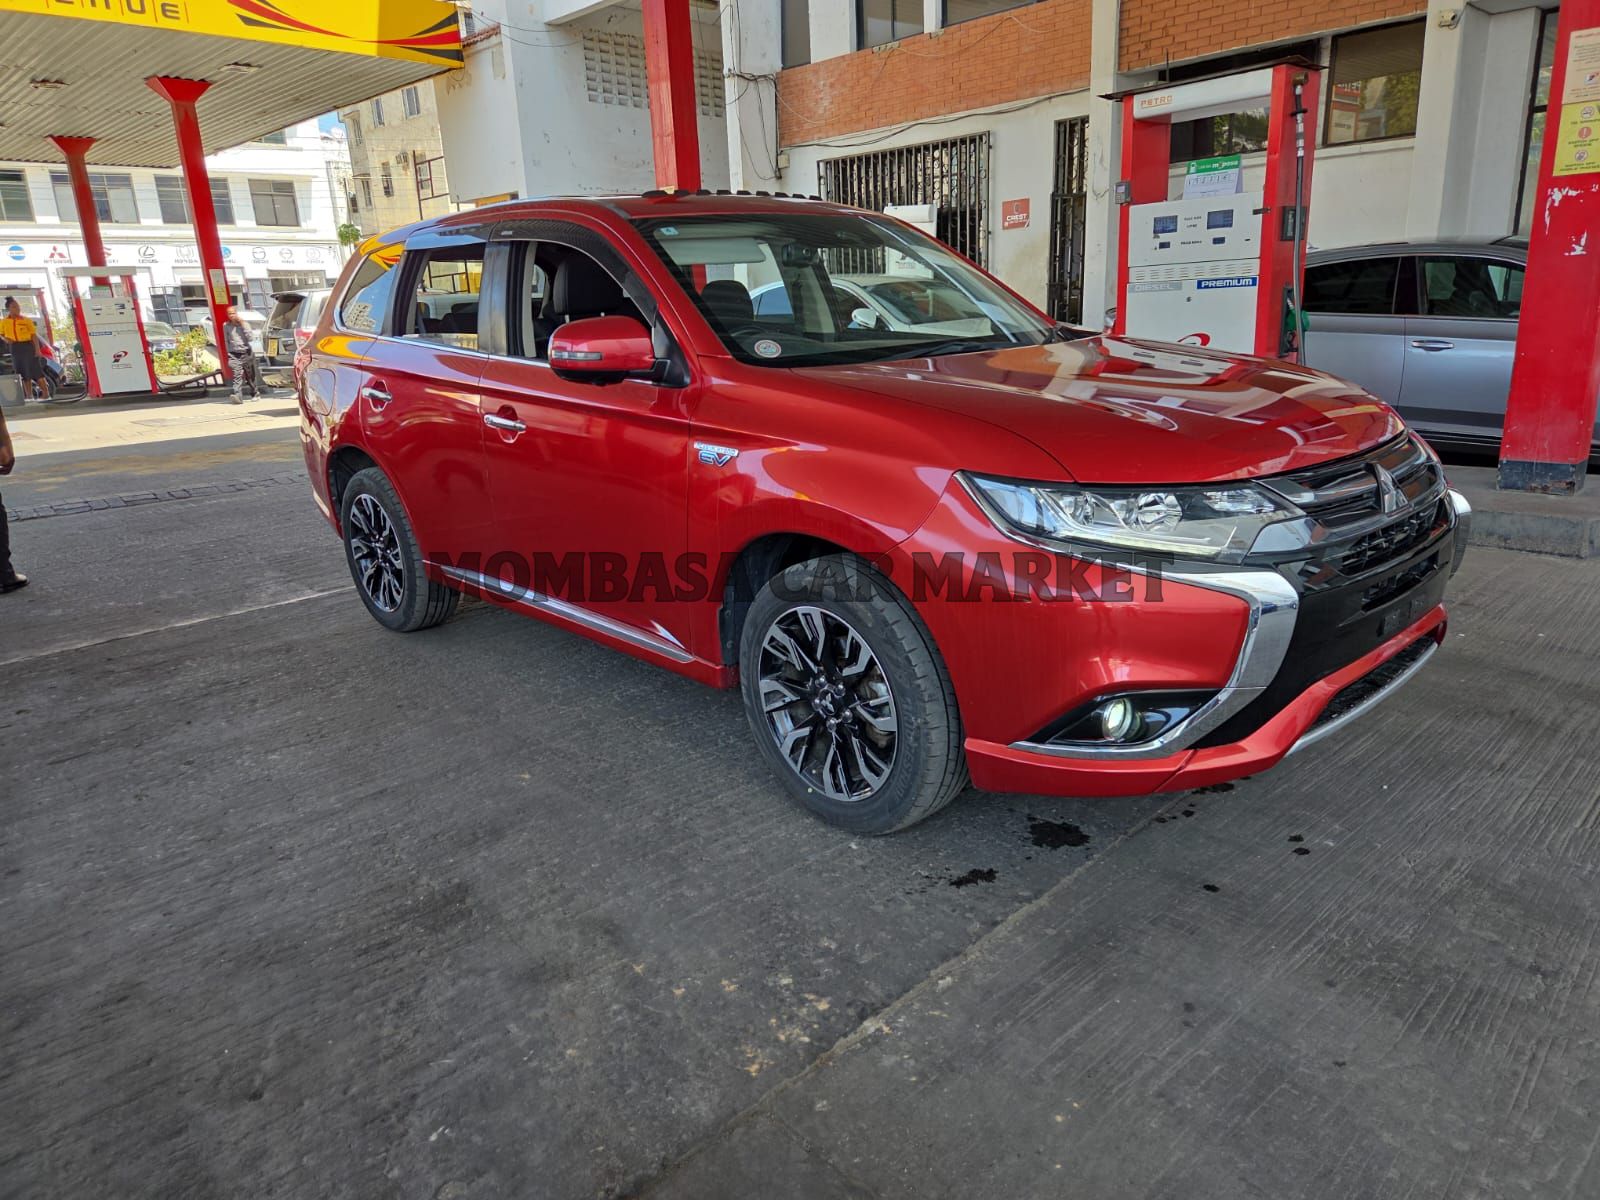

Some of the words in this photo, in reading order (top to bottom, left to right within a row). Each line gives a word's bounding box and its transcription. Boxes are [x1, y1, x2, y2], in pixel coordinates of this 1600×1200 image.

[1134, 283, 1175, 292] DIESEL
[1201, 278, 1253, 288] PREMIUM
[699, 450, 731, 466] EV
